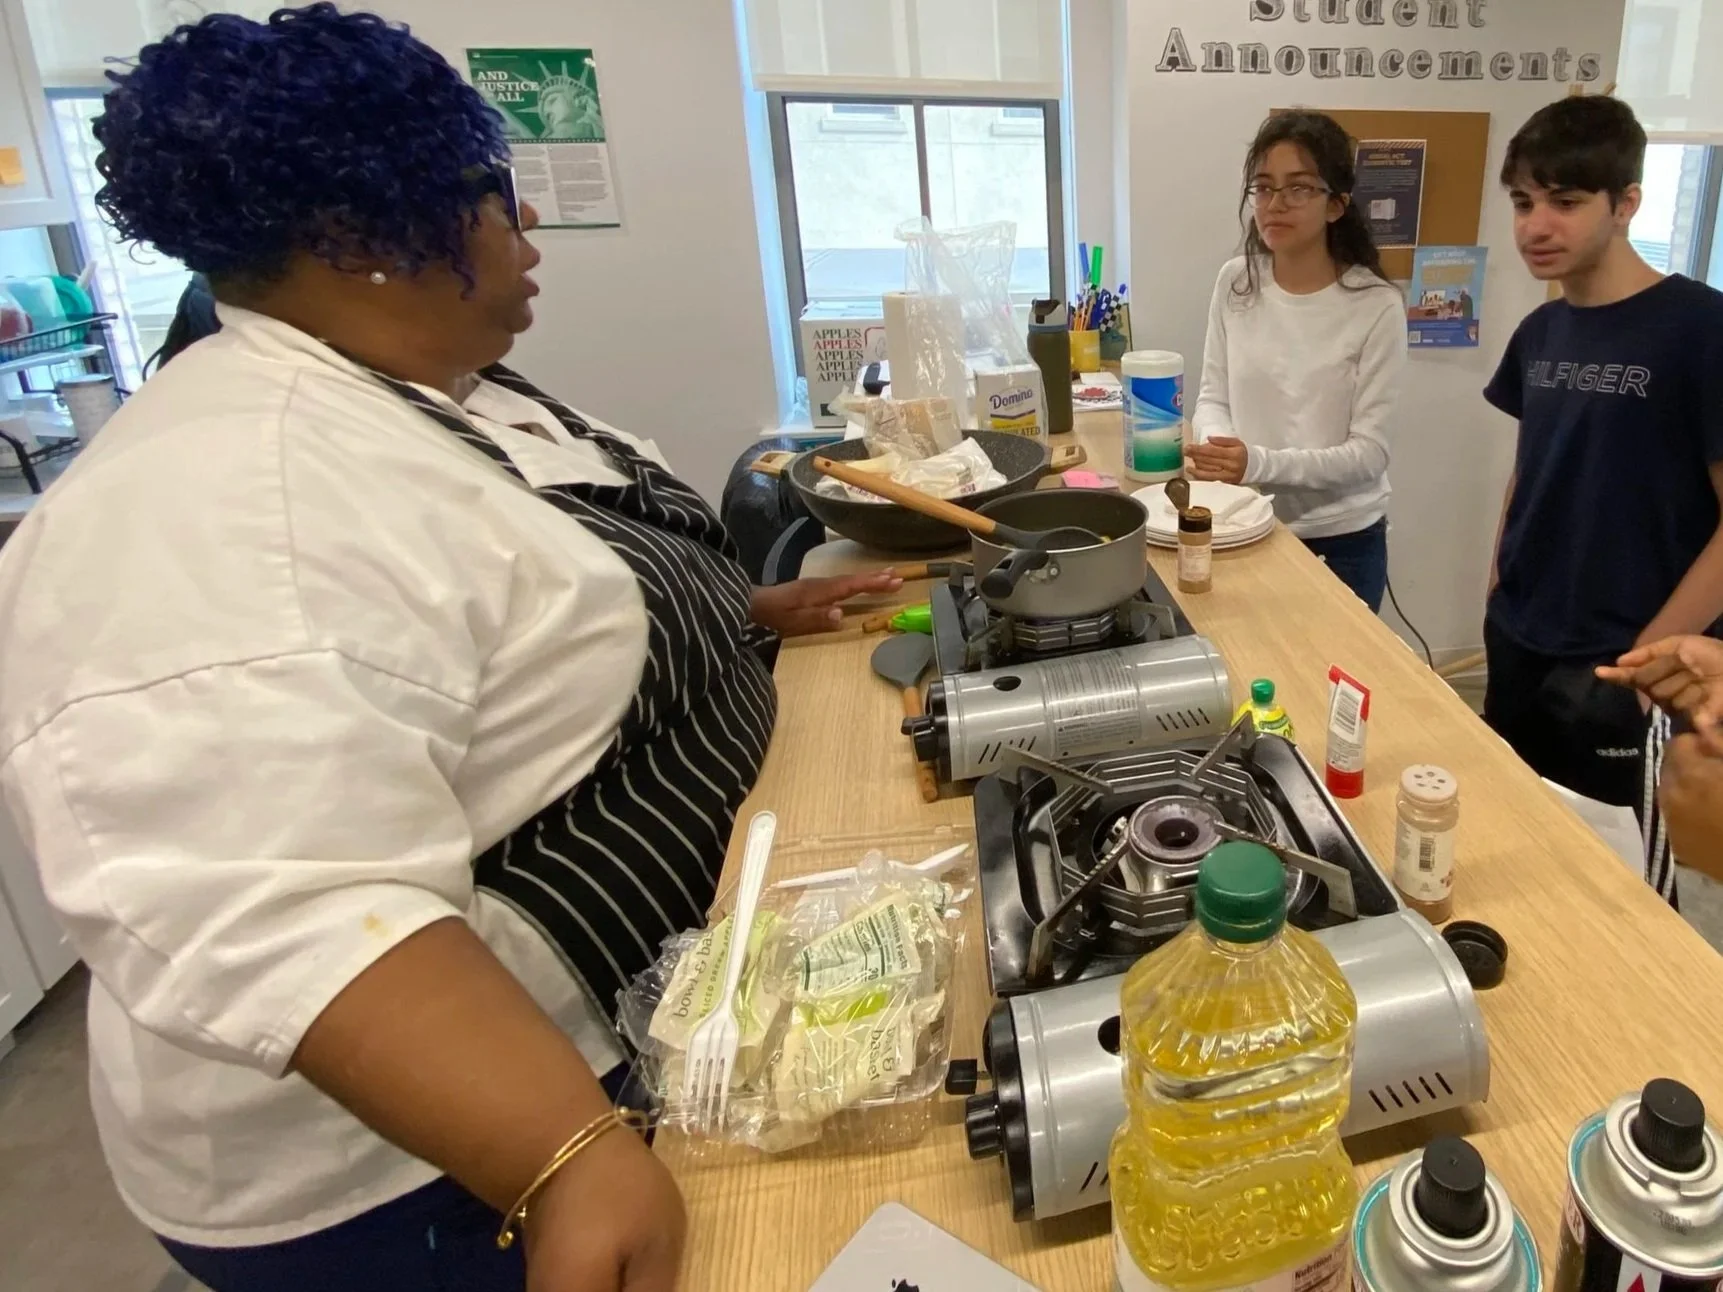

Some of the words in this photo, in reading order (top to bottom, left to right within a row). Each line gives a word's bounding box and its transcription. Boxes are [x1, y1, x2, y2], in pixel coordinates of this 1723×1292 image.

[1249, 0, 1485, 28] Student
[1155, 27, 1601, 81] Announcements
[477, 70, 508, 81] AND
[480, 81, 540, 92] JUSTICE
[496, 92, 525, 102] ALL
[812, 328, 862, 339] APPLES
[813, 339, 862, 350] APPLES
[815, 350, 864, 361] APPLES
[818, 371, 857, 382] APPLE
[1526, 360, 1650, 398] HILFIGER
[989, 388, 1033, 410] Domino
[1595, 747, 1639, 757] adidas
[886, 904, 901, 943] Nutrition
[896, 943, 908, 970] Facts
[672, 978, 698, 1018] bowl
[695, 959, 707, 974] &
[1294, 1253, 1332, 1280] Nutrition
